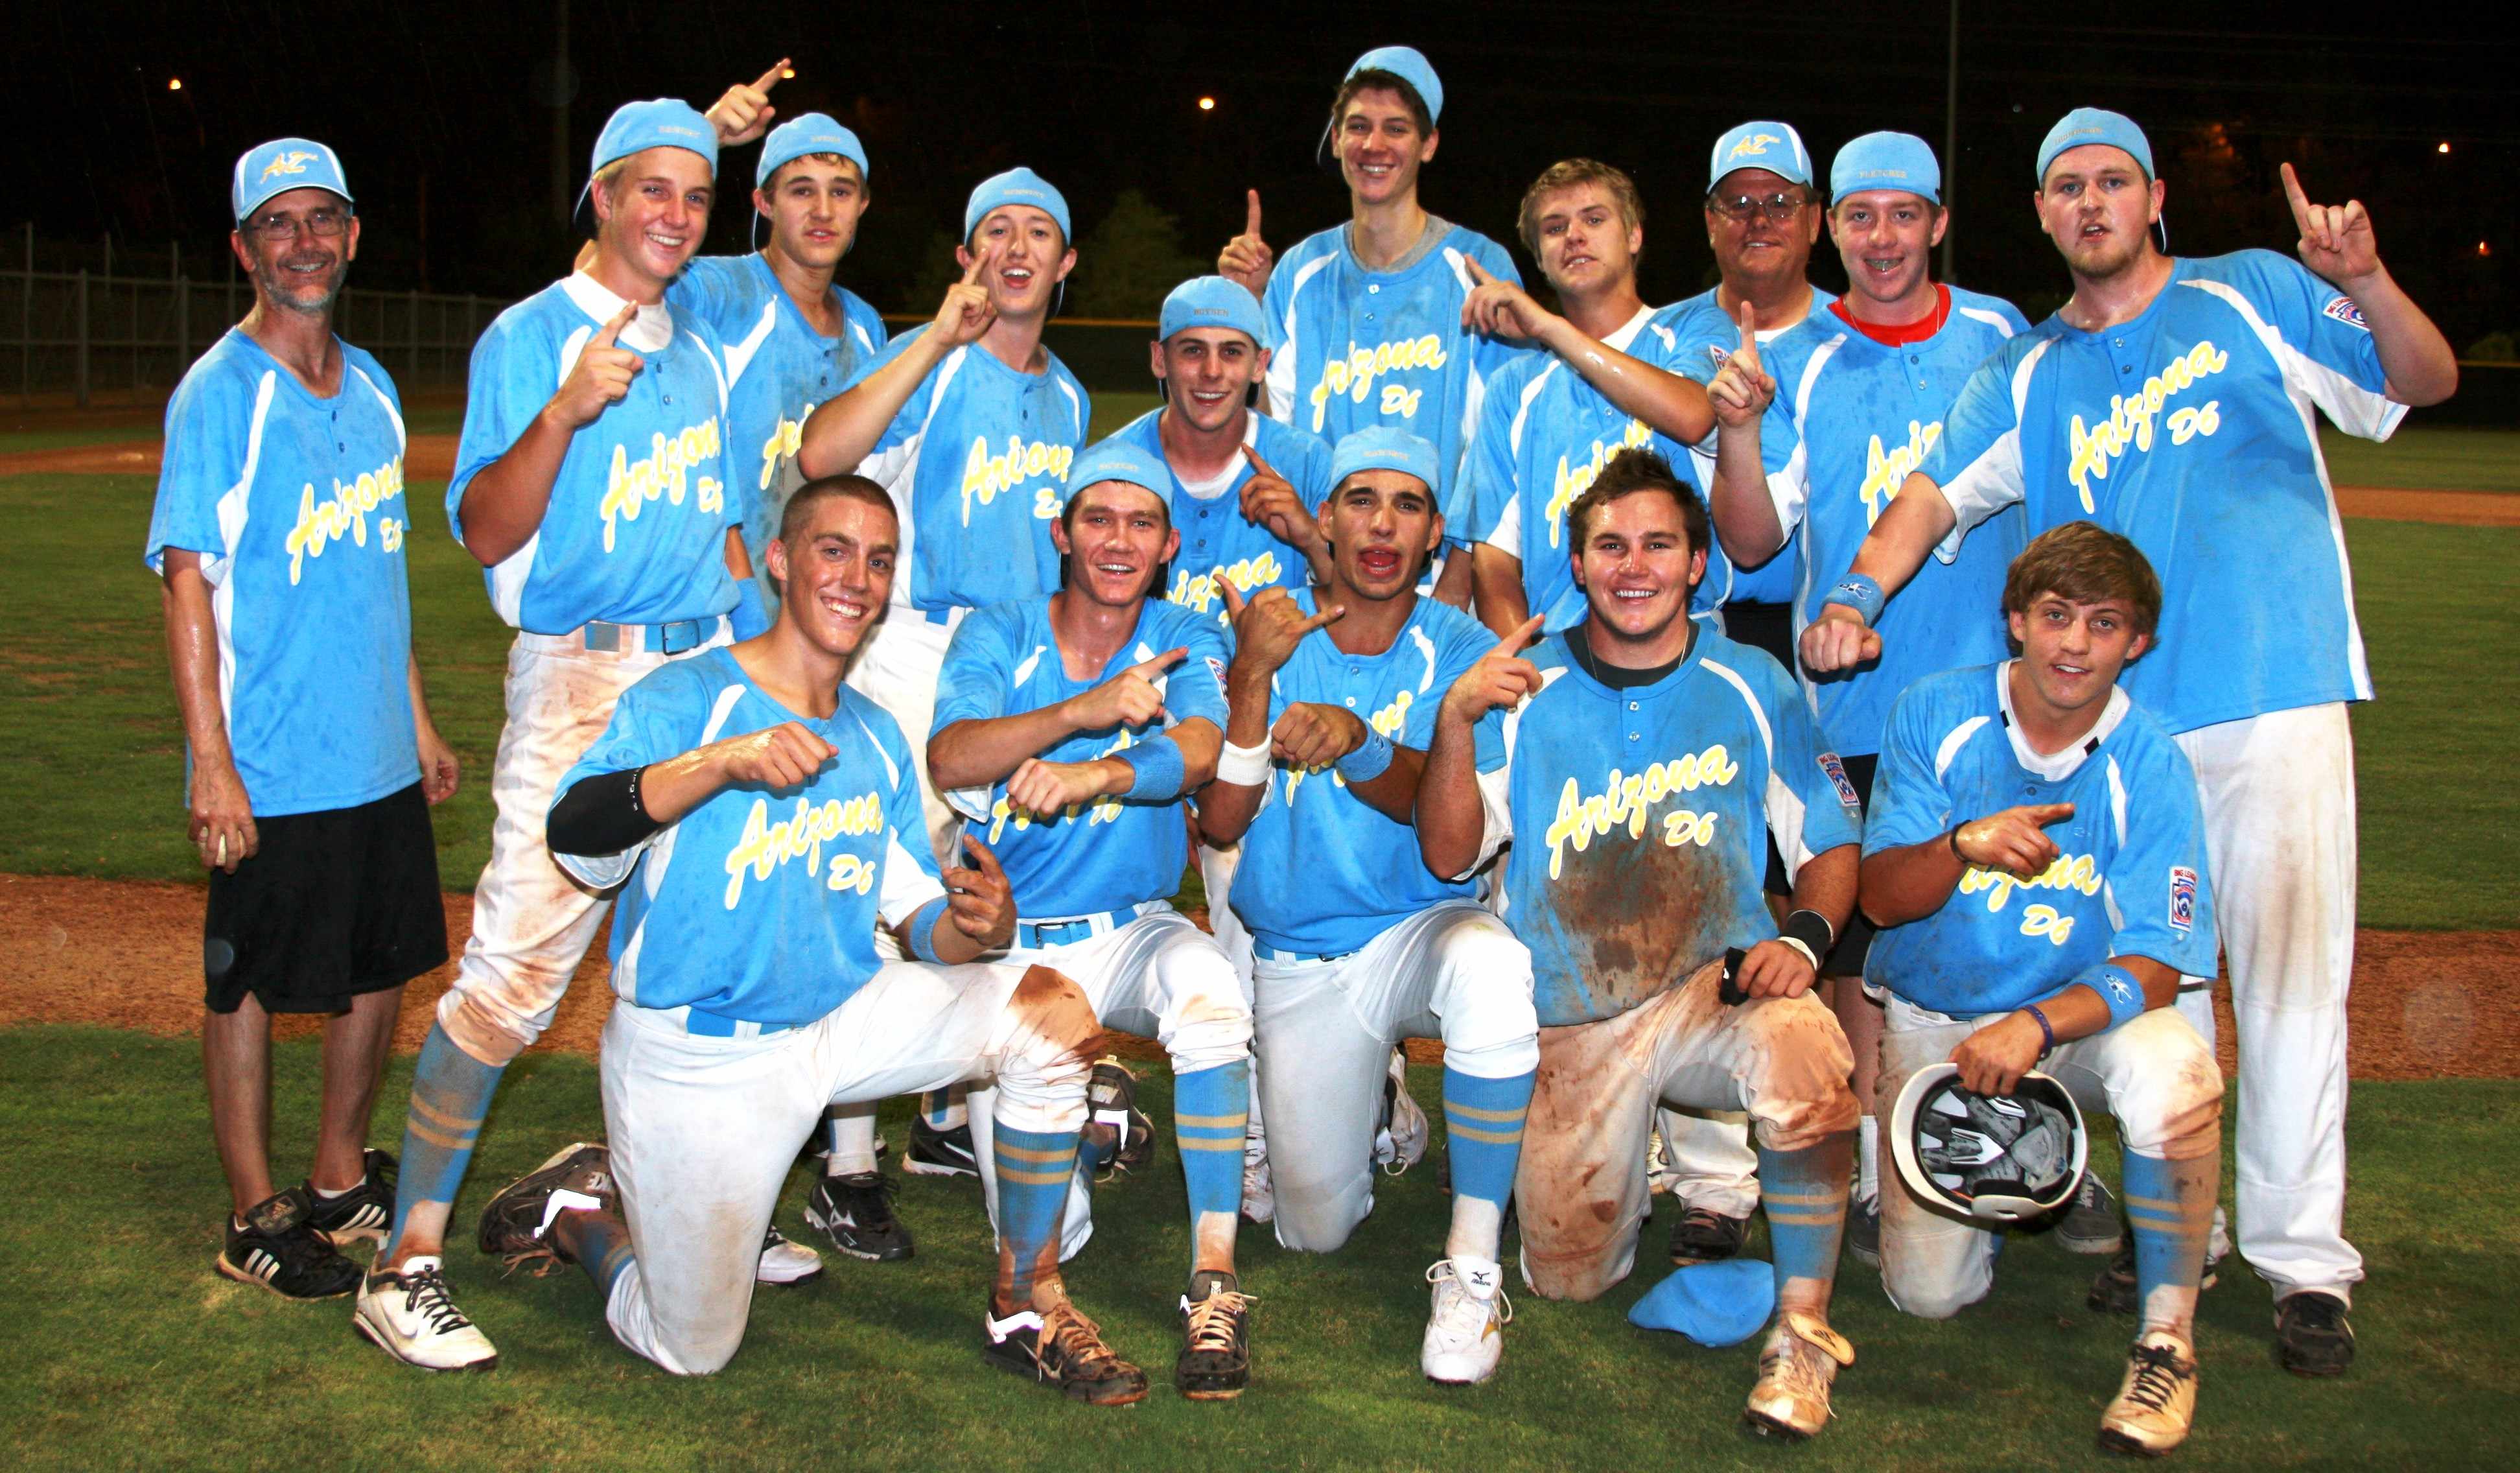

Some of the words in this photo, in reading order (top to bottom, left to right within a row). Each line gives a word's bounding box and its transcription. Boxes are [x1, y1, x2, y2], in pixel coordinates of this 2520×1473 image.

[260, 151, 319, 184] AZ
[1727, 134, 1780, 162] AZ
[1380, 384, 1423, 419] D6
[2068, 340, 2228, 515] Arizona
[2166, 400, 2220, 446] D6
[1545, 744, 1738, 880] Arizona
[1663, 810, 1719, 847] D6
[724, 791, 884, 910] Arizona
[827, 853, 876, 896] D6
[2020, 903, 2075, 945] D6
